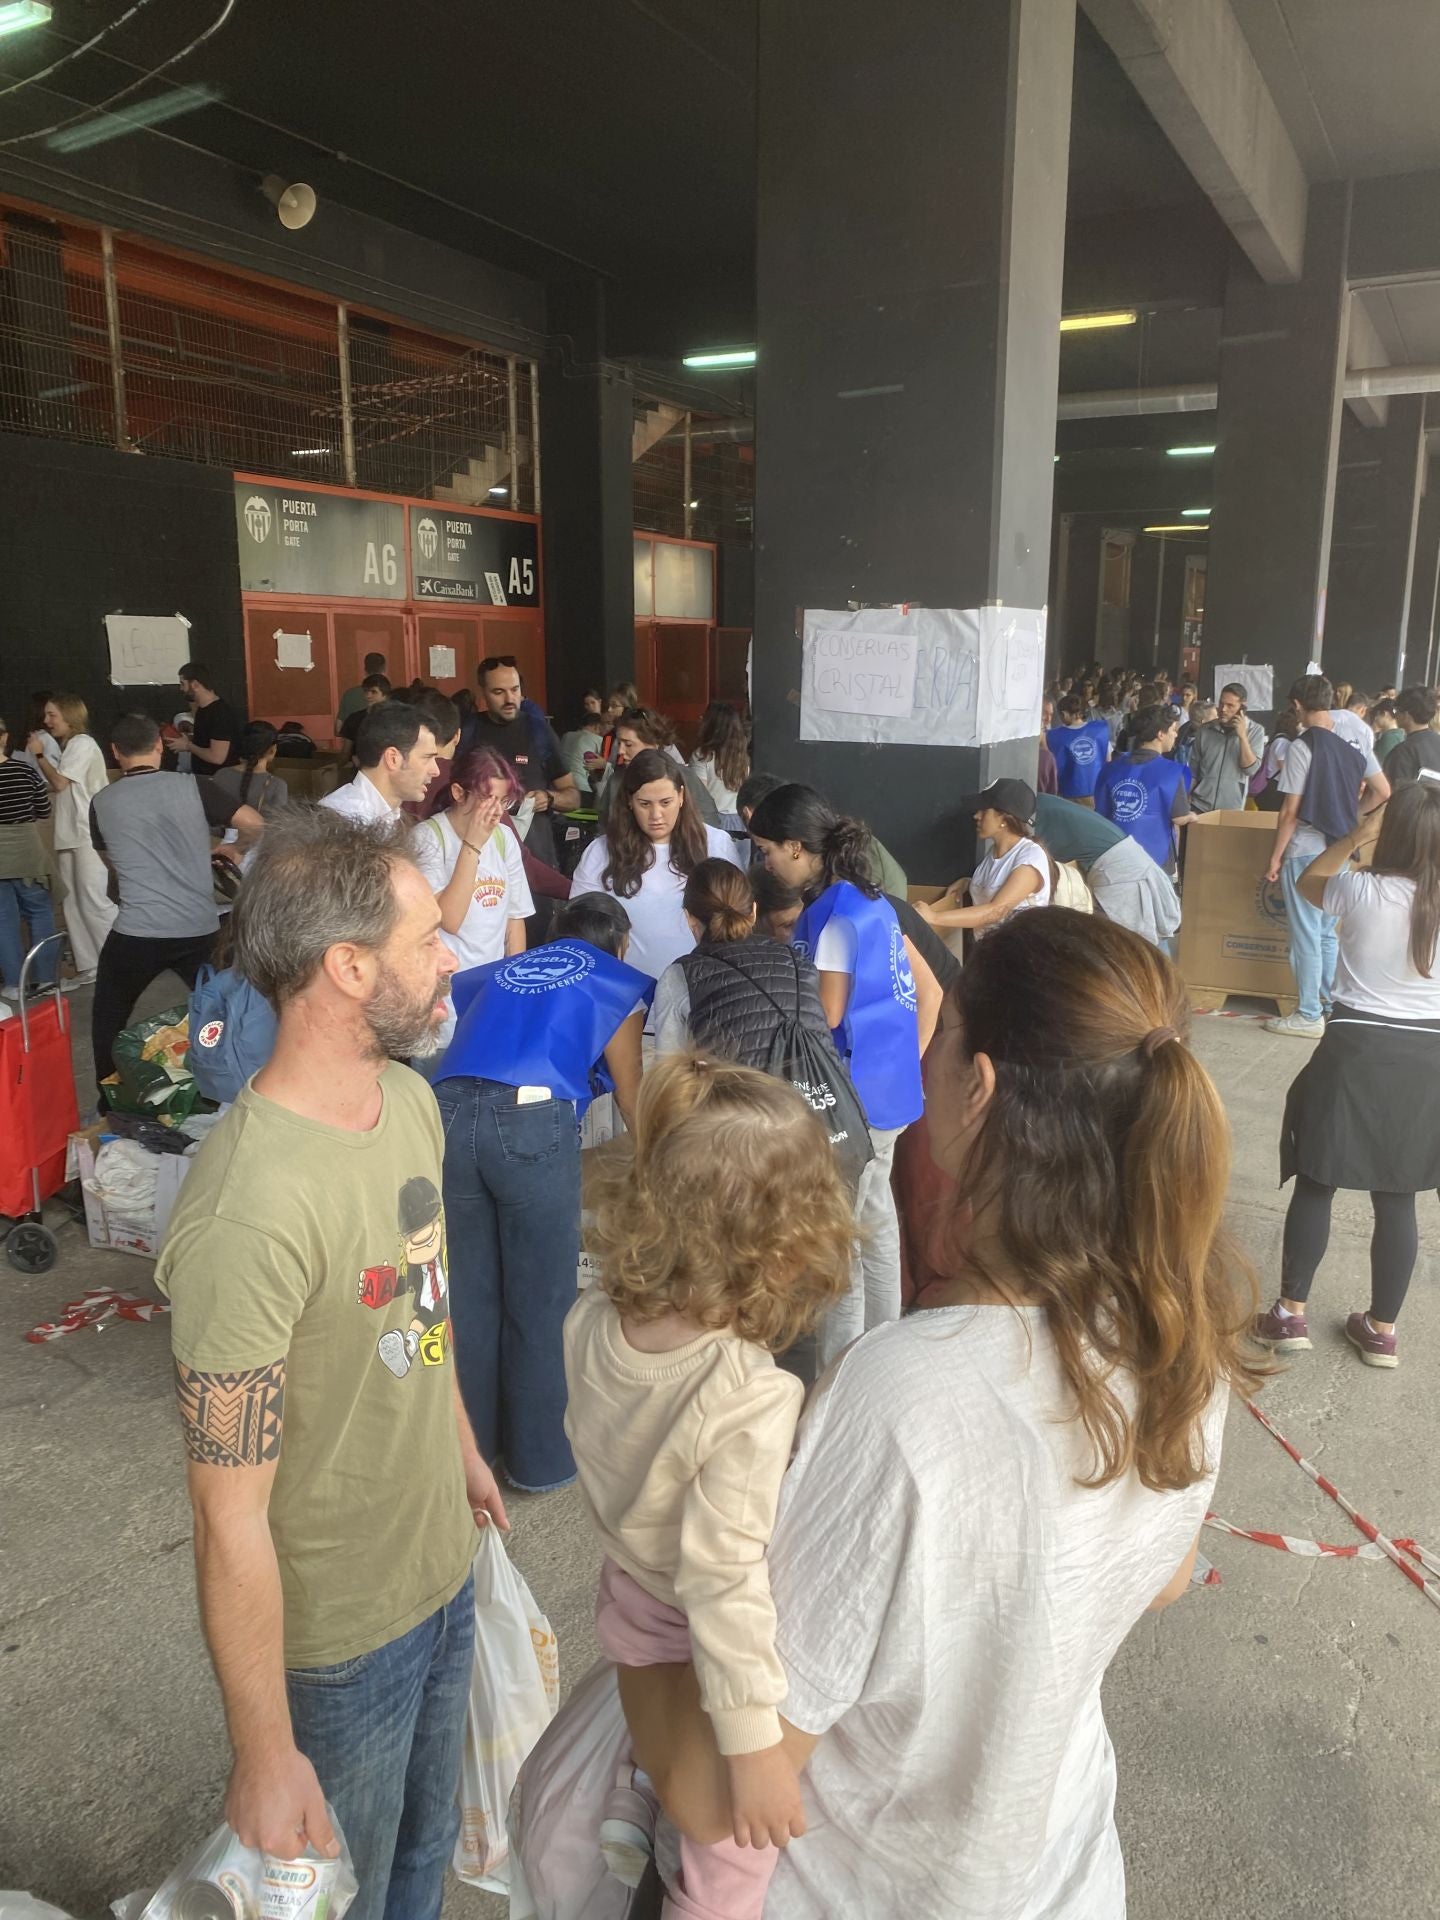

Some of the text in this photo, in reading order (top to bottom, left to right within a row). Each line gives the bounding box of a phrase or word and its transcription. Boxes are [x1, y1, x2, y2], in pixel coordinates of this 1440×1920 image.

[282, 499, 317, 517] PUERTA
[283, 518, 309, 533] PORTA
[446, 520, 472, 536] PUERTA
[284, 535, 301, 547] GATE
[447, 537, 466, 550] PORTA
[363, 541, 397, 586] A6
[447, 552, 460, 562] GATE
[508, 556, 534, 596] A5
[433, 580, 475, 597] CaixaBank
[818, 634, 912, 662] CONSERVAS
[817, 668, 905, 702] CRISTAL
[524, 956, 577, 964] FESBAL
[512, 986, 527, 995] DE
[528, 970, 590, 995] ALIMENTOS
